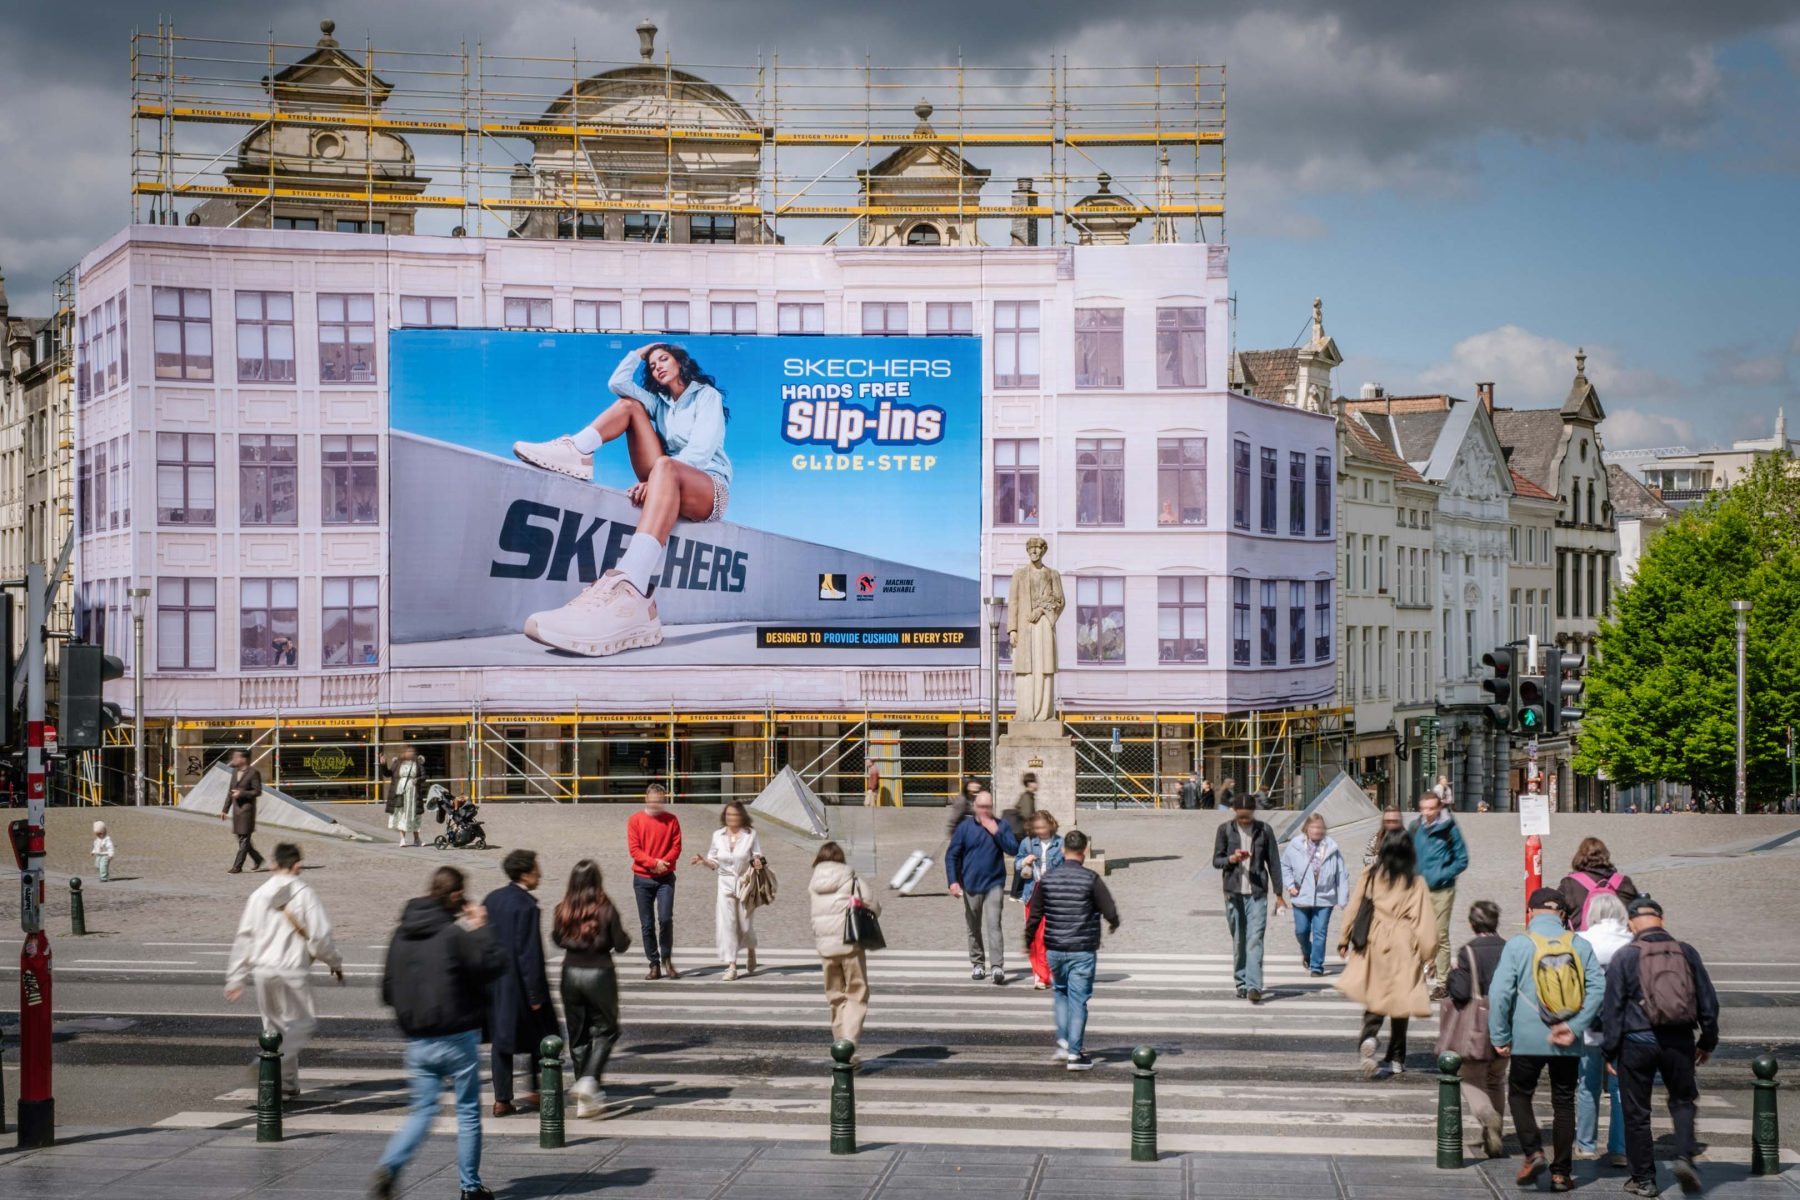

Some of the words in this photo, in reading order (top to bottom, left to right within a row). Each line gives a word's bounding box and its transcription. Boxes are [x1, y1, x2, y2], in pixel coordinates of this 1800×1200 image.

[783, 358, 952, 378] SKECHERS
[781, 383, 853, 400] HANDS
[858, 381, 911, 398] FREE
[786, 400, 943, 448] Slip-ins
[791, 454, 938, 471] GLIDE-STEP
[489, 498, 749, 593] SKEHERS
[766, 632, 807, 644] DESIGNED
[810, 632, 821, 643] TO
[823, 632, 860, 644] PROVIDE
[862, 632, 899, 644] CUSHION
[901, 632, 911, 644] IN
[913, 632, 940, 644] EVERY
[942, 632, 964, 643] STEP
